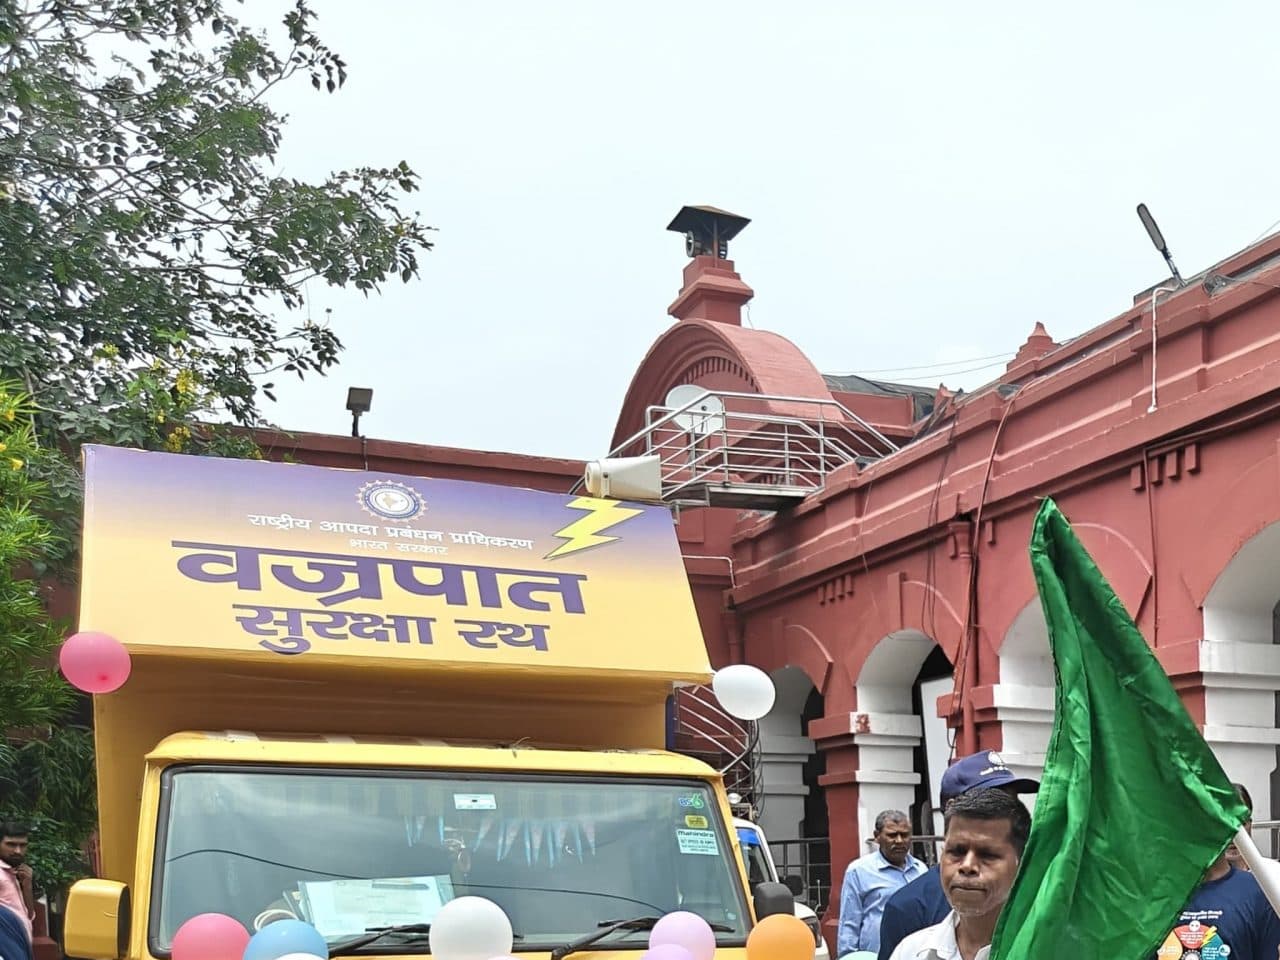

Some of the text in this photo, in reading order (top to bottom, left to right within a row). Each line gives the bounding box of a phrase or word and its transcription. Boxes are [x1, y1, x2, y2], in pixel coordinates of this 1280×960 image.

[247, 513, 535, 550] राष्ट्रीय आपदा प्रबंधन प्राधिकरण
[350, 538, 448, 555] भारत सरकार
[171, 540, 587, 615] वज्रपात
[232, 603, 550, 654] सुरक्षा रथ
